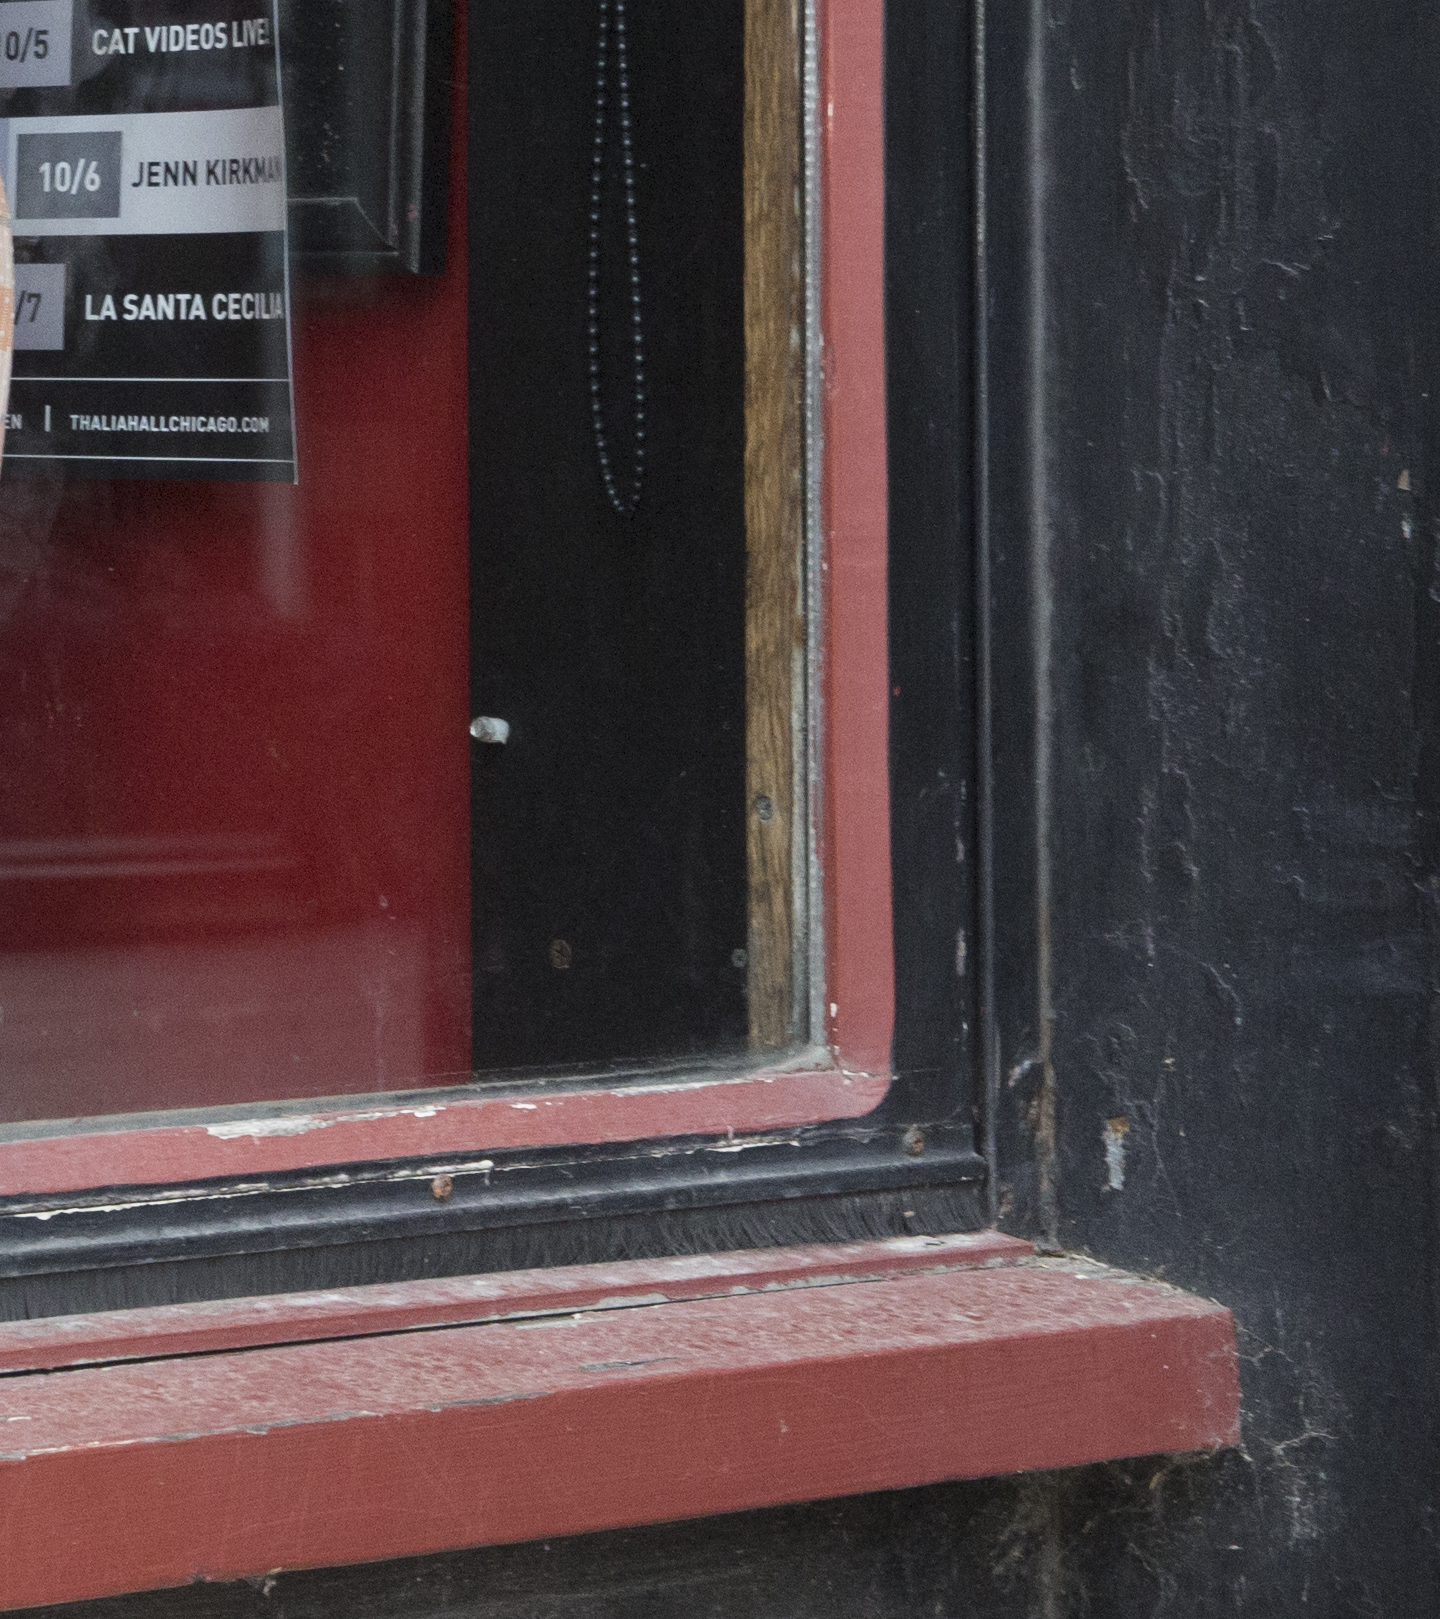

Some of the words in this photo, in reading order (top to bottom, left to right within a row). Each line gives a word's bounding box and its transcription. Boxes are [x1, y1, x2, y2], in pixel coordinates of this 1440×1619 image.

[92, 26, 140, 56] CAT
[144, 21, 230, 54] VIDEOS
[36, 157, 102, 197] 10/6
[131, 160, 198, 189] JENN
[85, 293, 118, 321] LA
[122, 292, 208, 321] SANTA
[69, 413, 270, 433] THALIAHALLCHICAGO.COM
